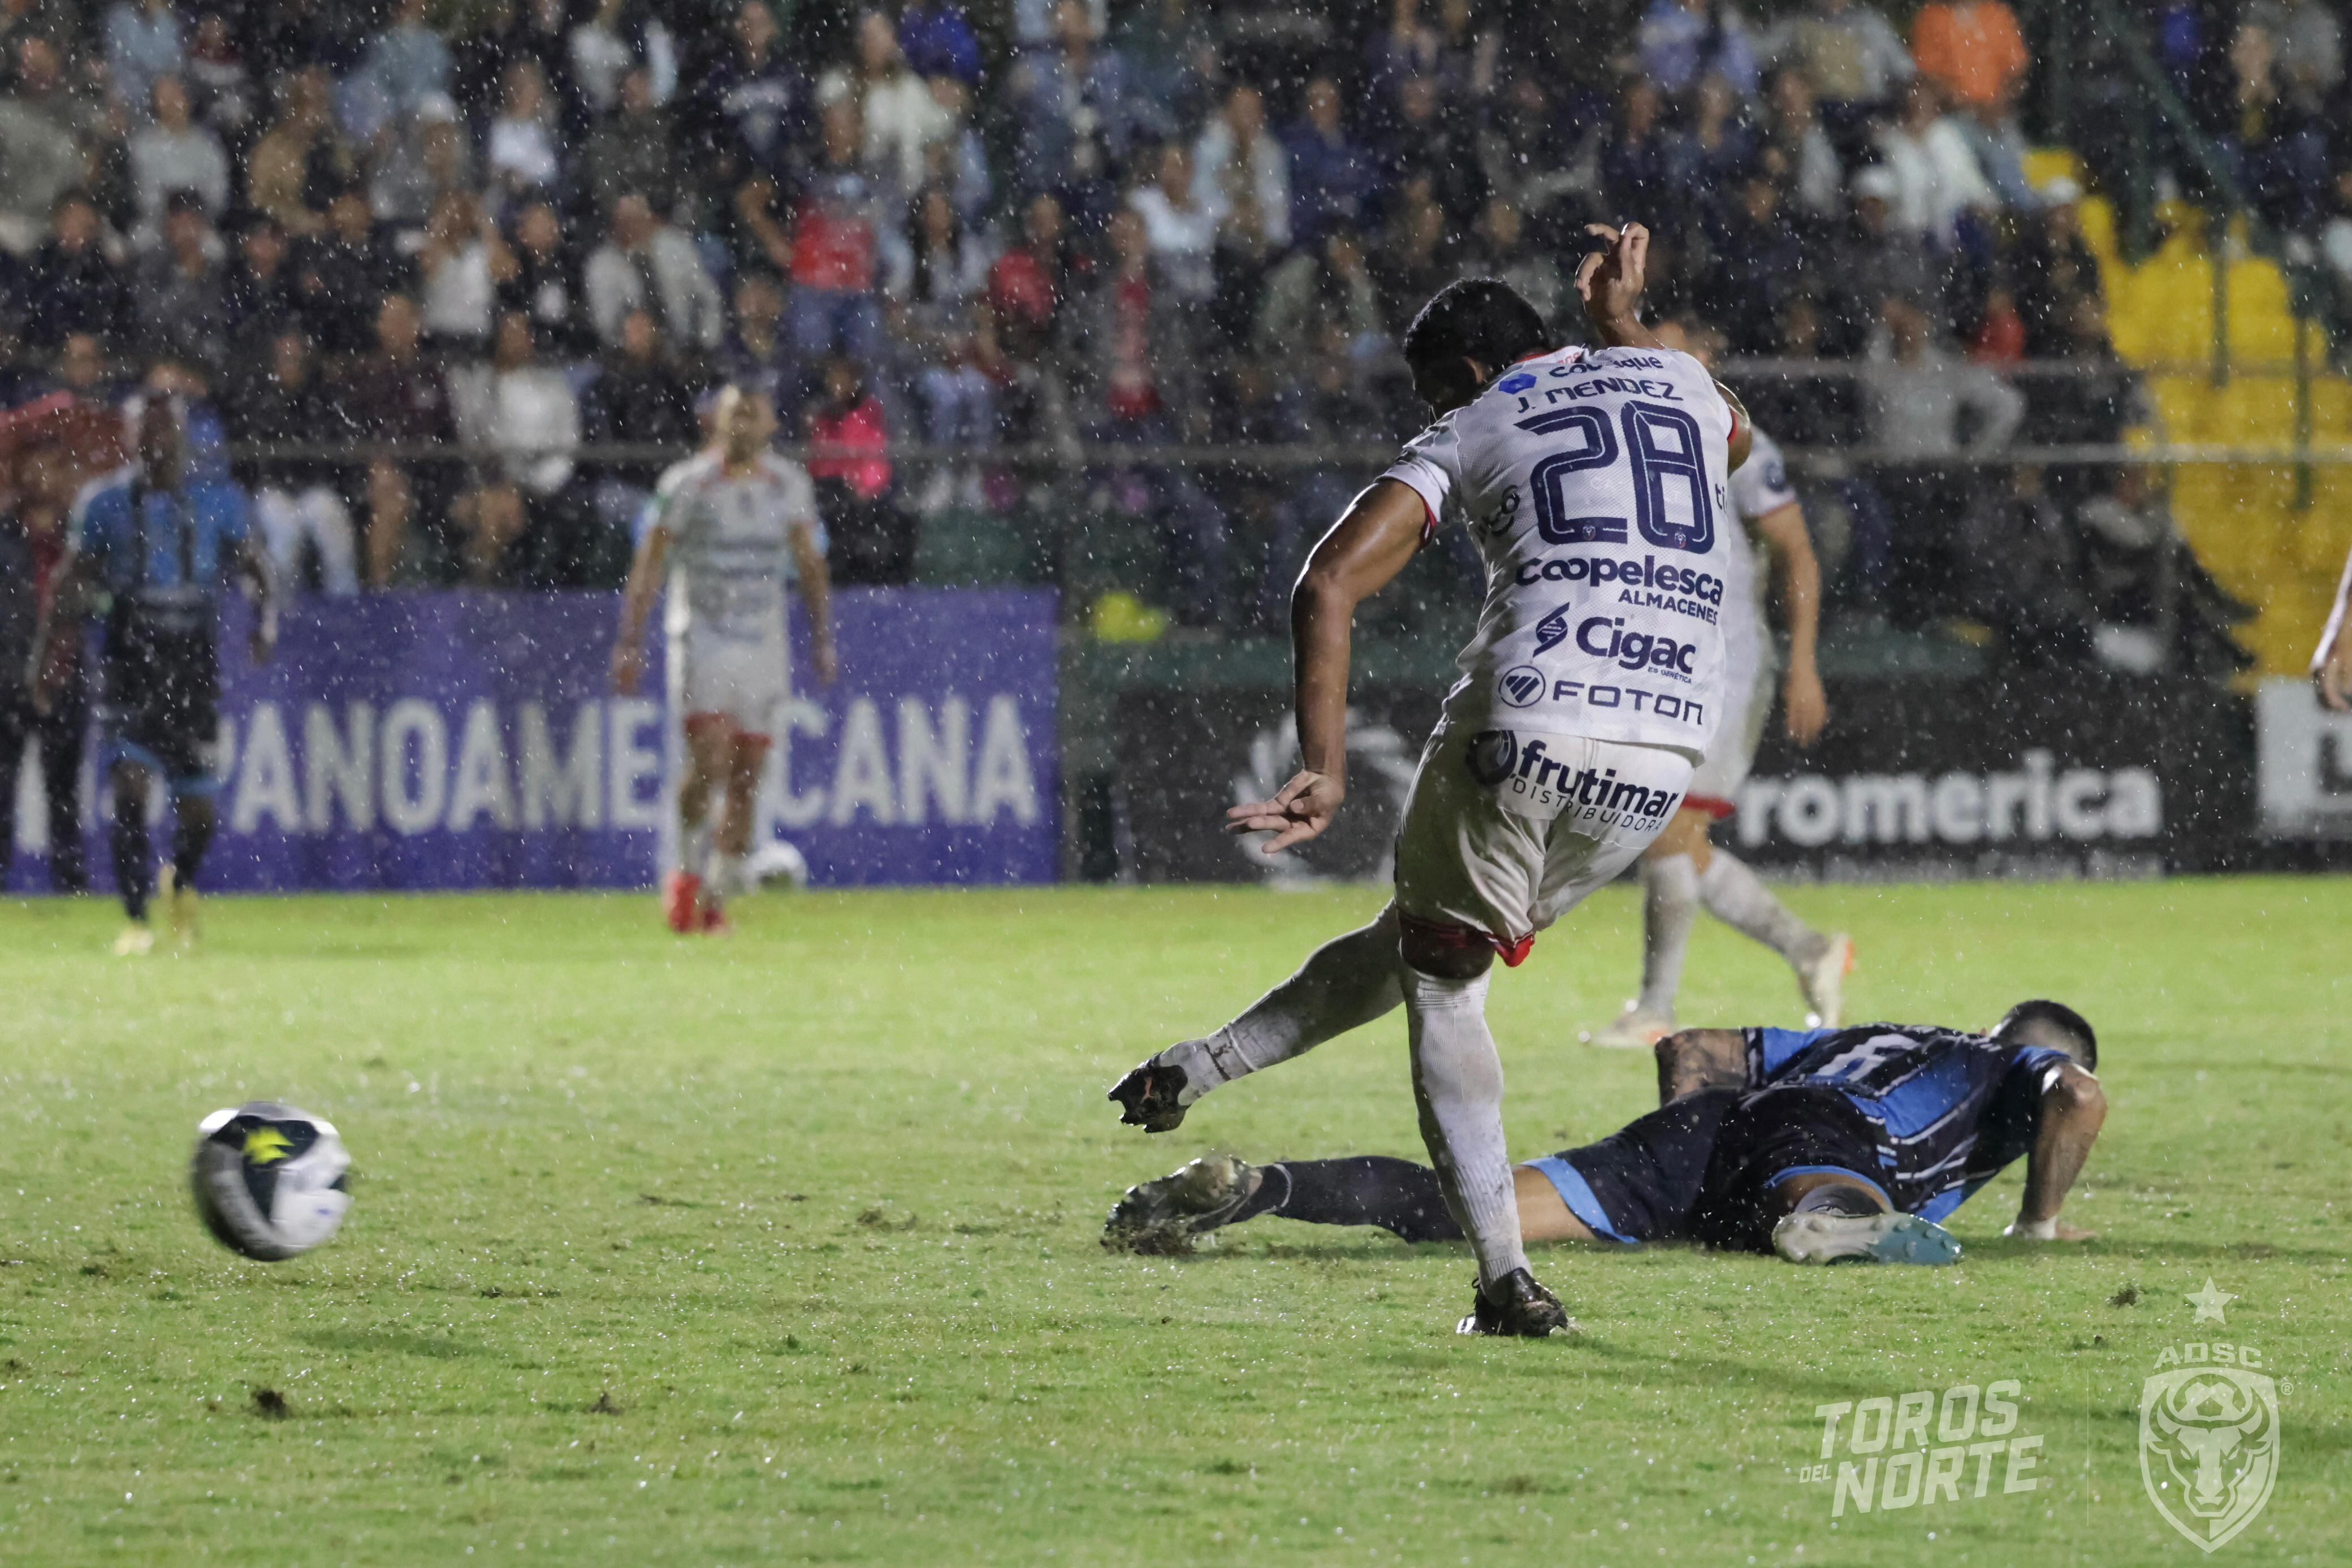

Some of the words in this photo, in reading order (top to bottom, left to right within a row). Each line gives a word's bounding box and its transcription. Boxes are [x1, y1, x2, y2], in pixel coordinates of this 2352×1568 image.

[1517, 396, 1536, 414] J.
[1545, 377, 1683, 404] MENDEZ
[1513, 400, 1715, 555] 28
[1618, 588, 1718, 626] ALMACENES
[1576, 616, 1696, 674] Cigac
[1553, 680, 1703, 725] FOTON
[1512, 778, 1663, 833] DISTRIBUIDORA
[1519, 739, 1679, 818] frutimar
